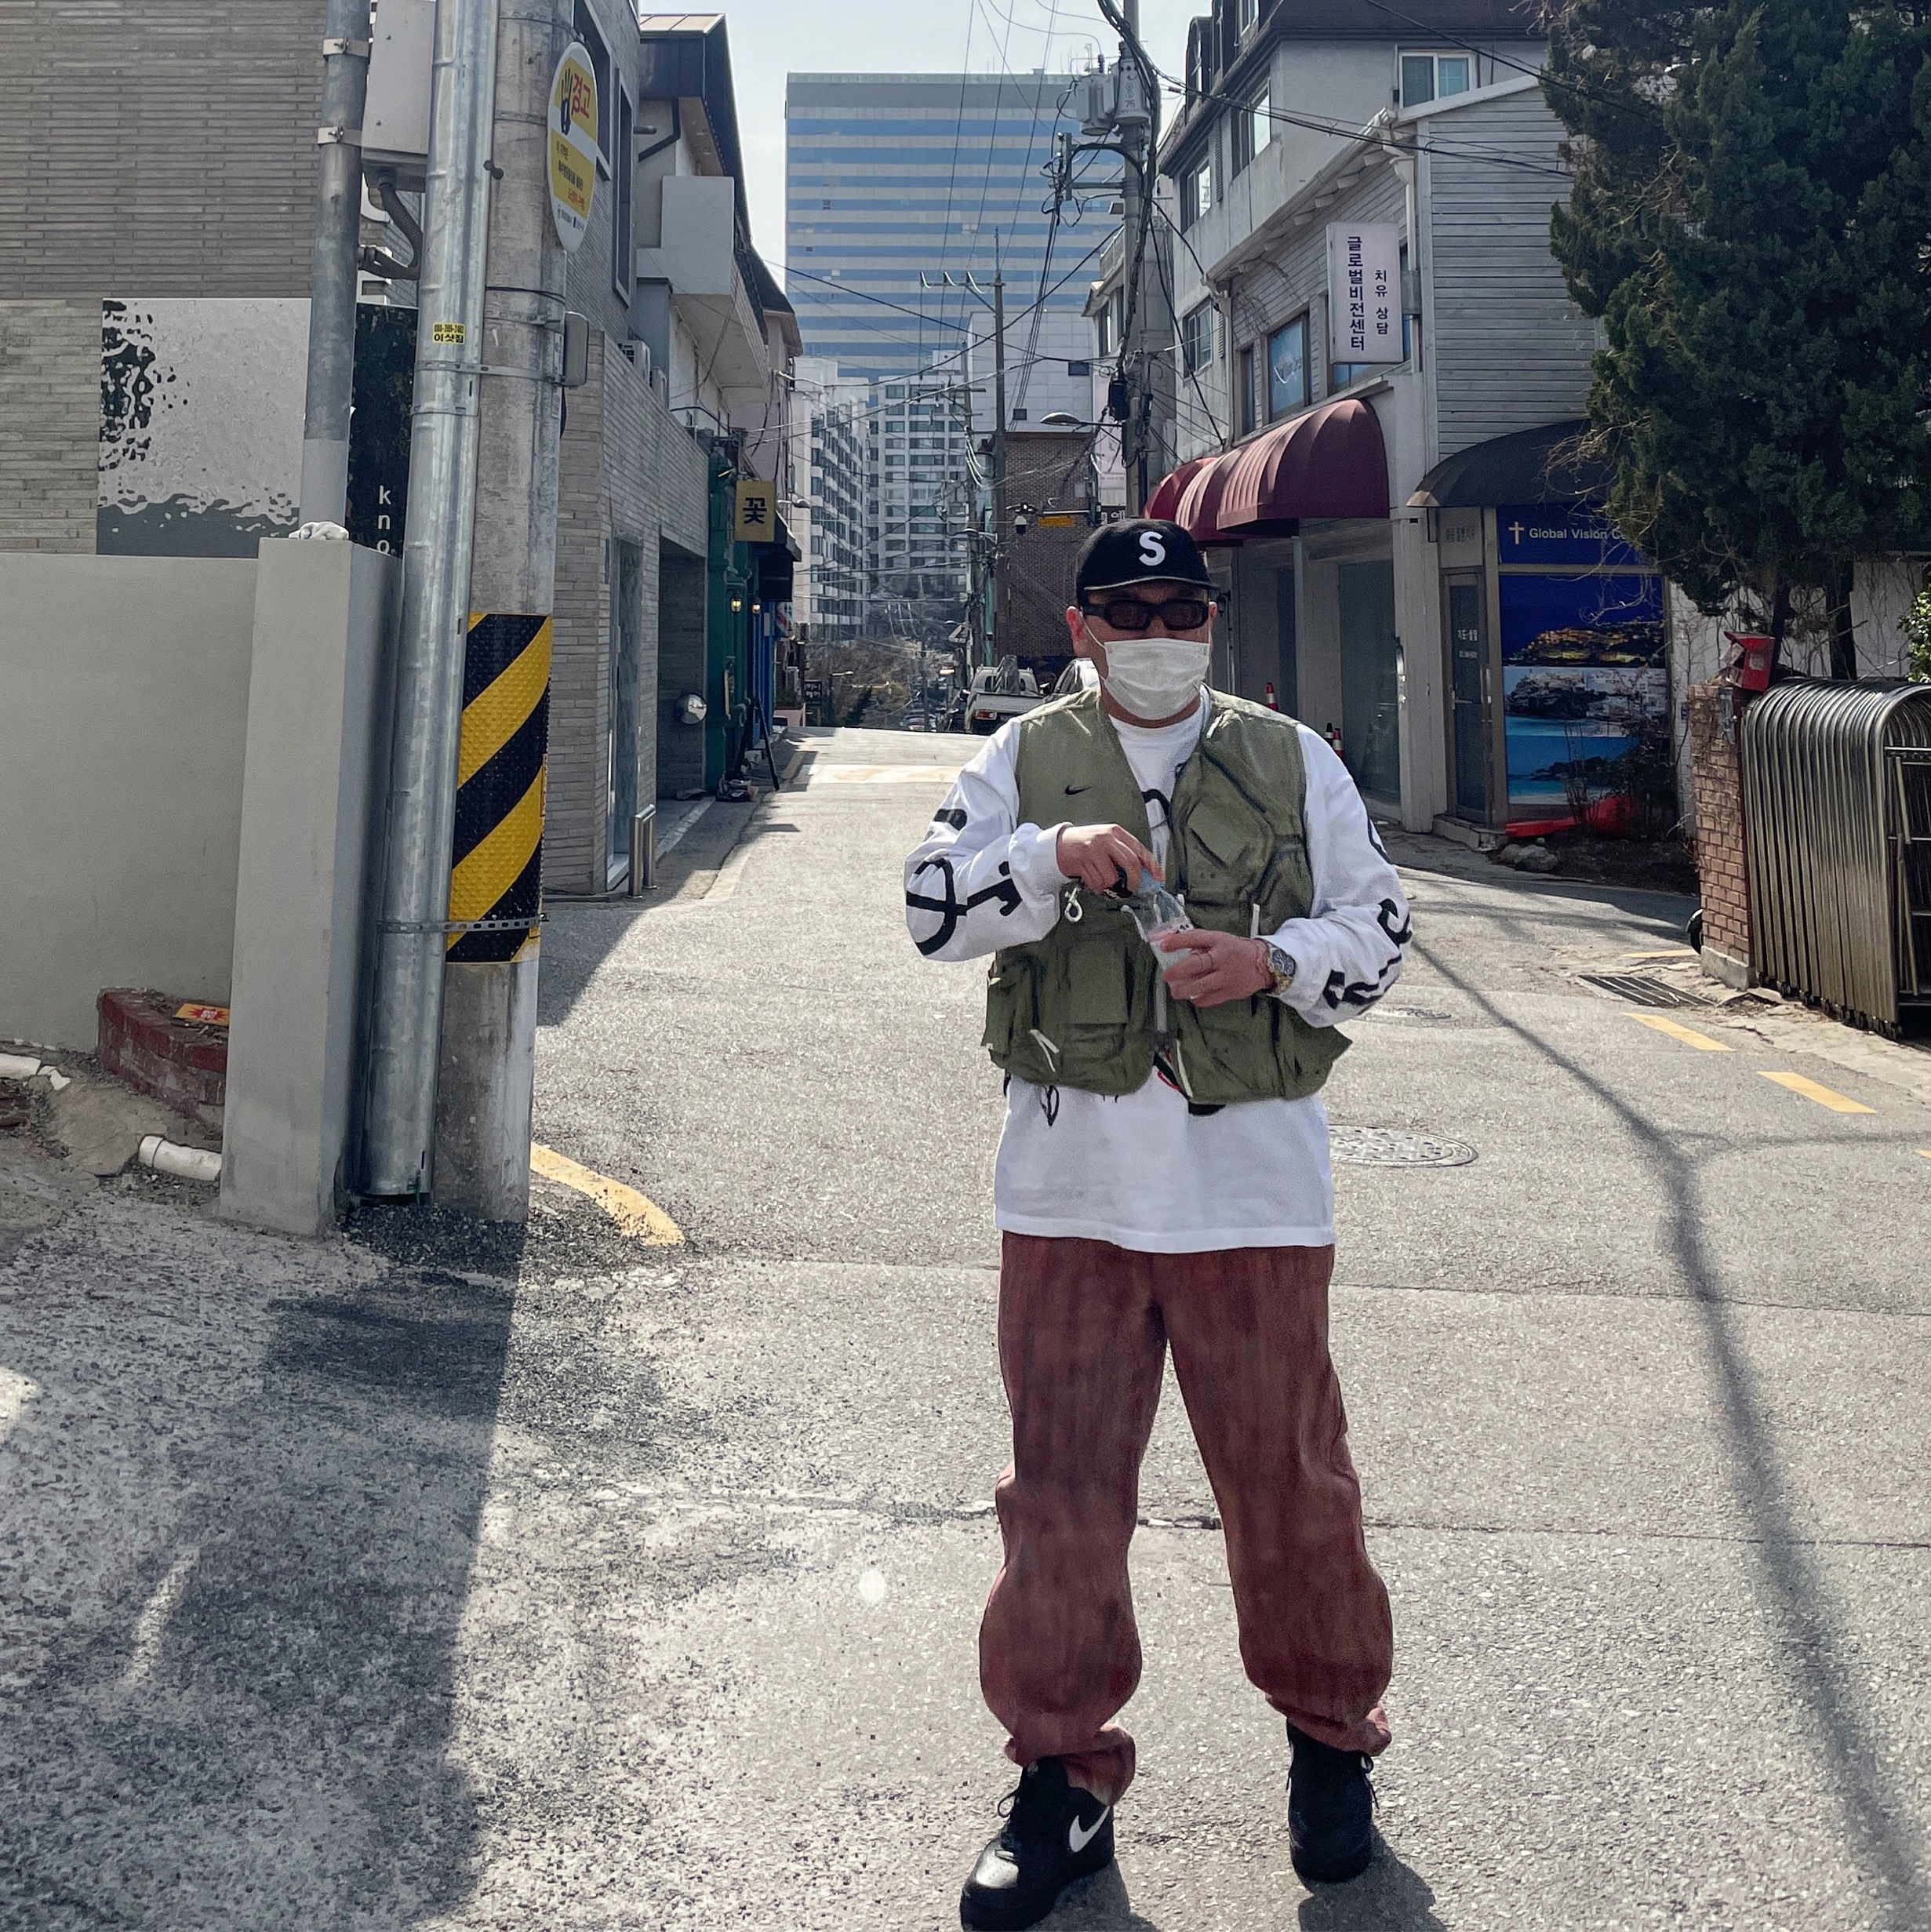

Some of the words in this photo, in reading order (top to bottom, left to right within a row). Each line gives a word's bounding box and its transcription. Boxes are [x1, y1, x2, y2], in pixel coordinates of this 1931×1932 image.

[571, 72, 591, 119] 경고
[1347, 236, 1366, 351] 글로벌비전센터
[1375, 270, 1387, 298] 치유
[1376, 307, 1389, 335] 상담
[434, 333, 464, 343] 이삿짐
[742, 497, 767, 525] 꽃
[1529, 528, 1567, 539] Global
[1571, 528, 1608, 540] Vision
[1139, 531, 1166, 566] S
